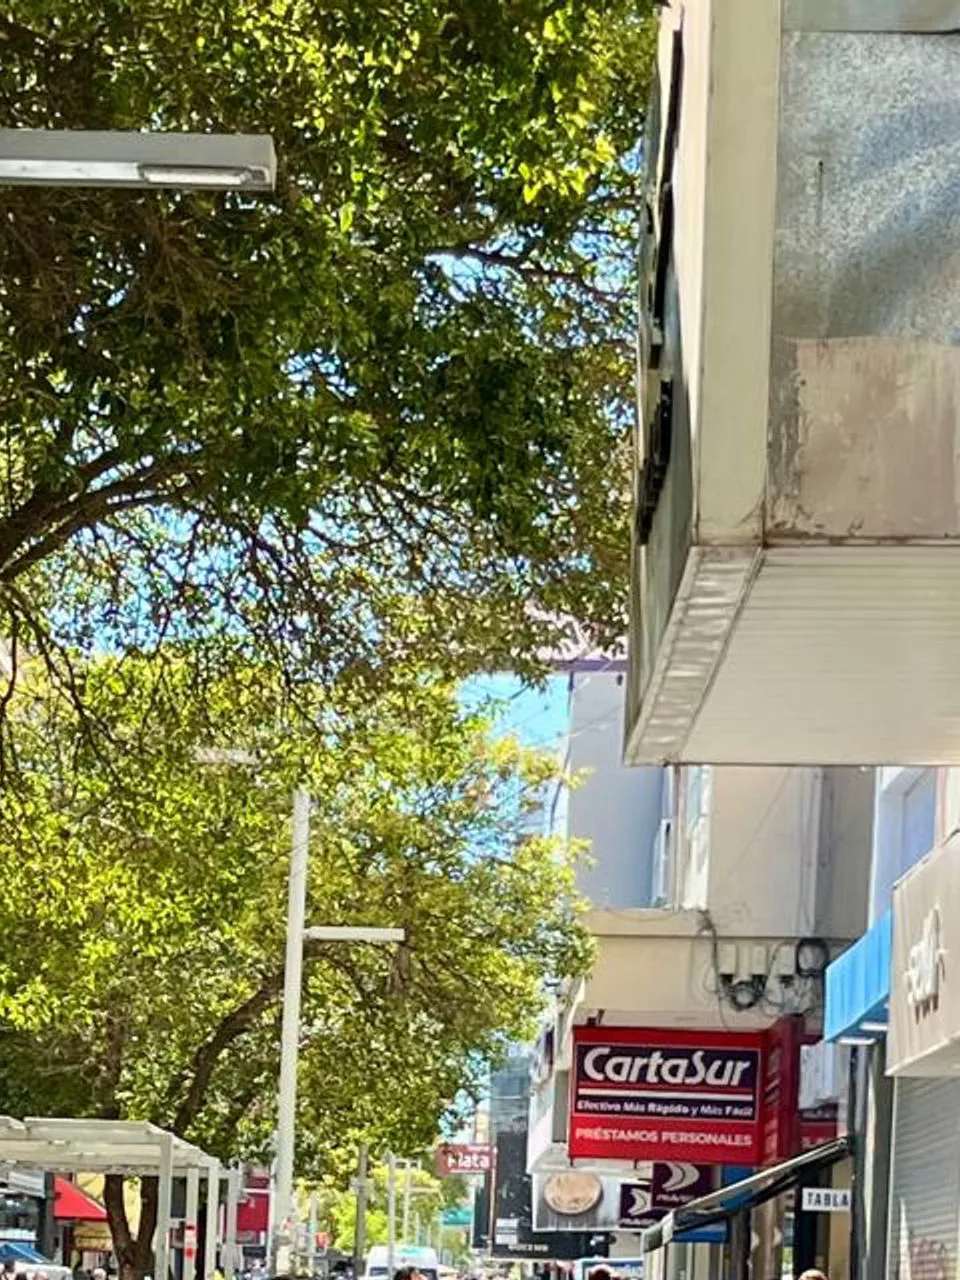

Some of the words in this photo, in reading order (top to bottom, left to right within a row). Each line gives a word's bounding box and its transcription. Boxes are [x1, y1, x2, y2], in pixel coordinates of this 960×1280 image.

[583, 1046, 751, 1087] CartaSur
[576, 1099, 622, 1112] Efectivo
[623, 1100, 645, 1113] Más
[647, 1101, 689, 1115] Rápido
[690, 1106, 700, 1116] y
[575, 1126, 658, 1143] PRÉSTAMOS
[661, 1131, 753, 1147] PERSONALES
[807, 1191, 849, 1207] TABLA
